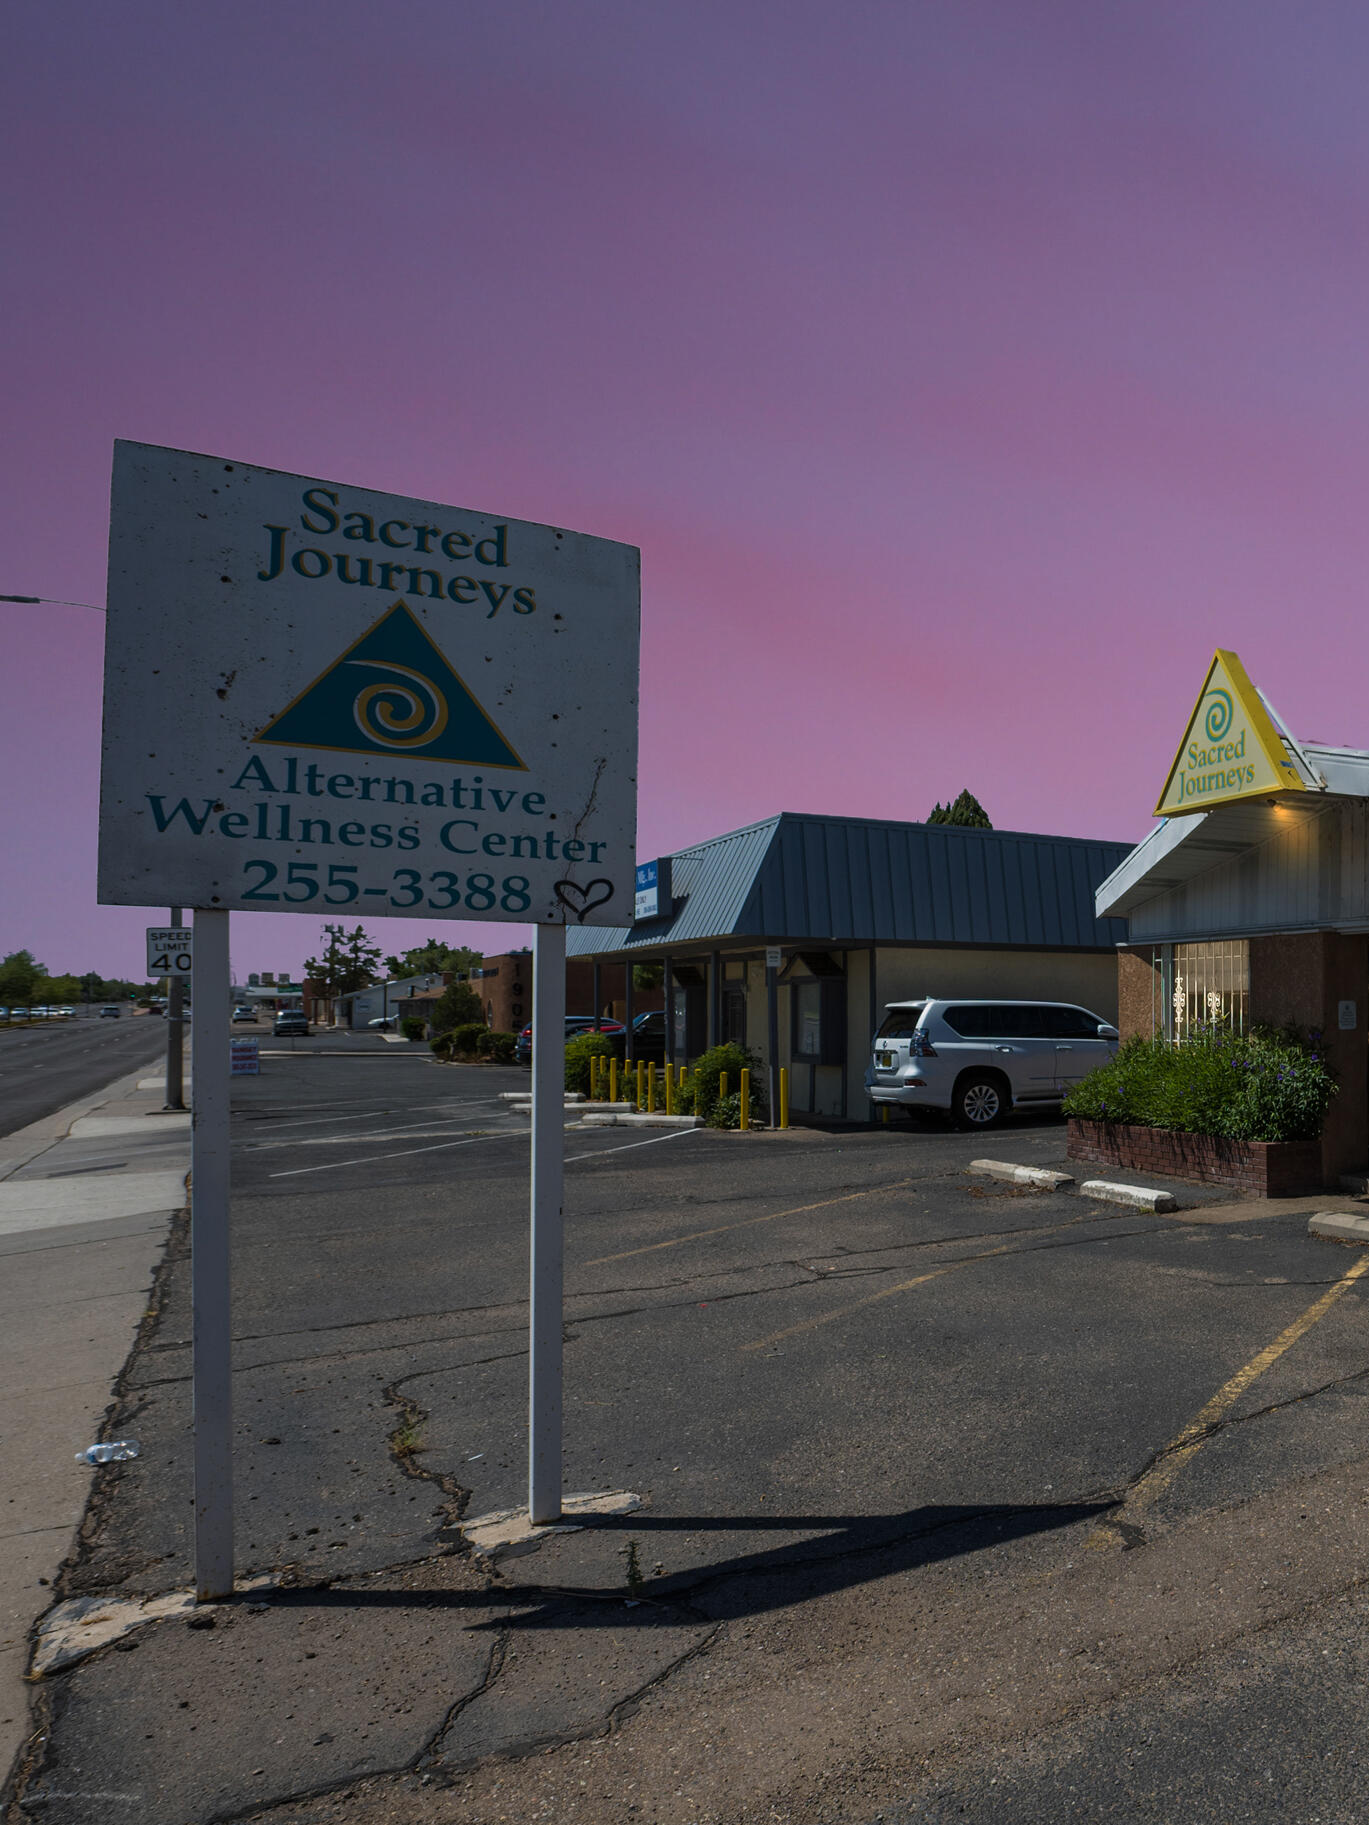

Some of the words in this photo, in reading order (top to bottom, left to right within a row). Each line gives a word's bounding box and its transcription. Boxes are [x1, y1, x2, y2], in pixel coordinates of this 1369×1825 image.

[301, 488, 510, 567] Sacred
[257, 524, 537, 619] Journeys
[1188, 728, 1246, 770] Sacred
[230, 755, 546, 815] Alternative
[1178, 764, 1255, 804] Journeys
[145, 794, 420, 850] Wellness
[440, 820, 607, 863] Center
[241, 860, 531, 913] 255-3388
[151, 953, 192, 972] 40
[155, 942, 188, 951] LIMIT
